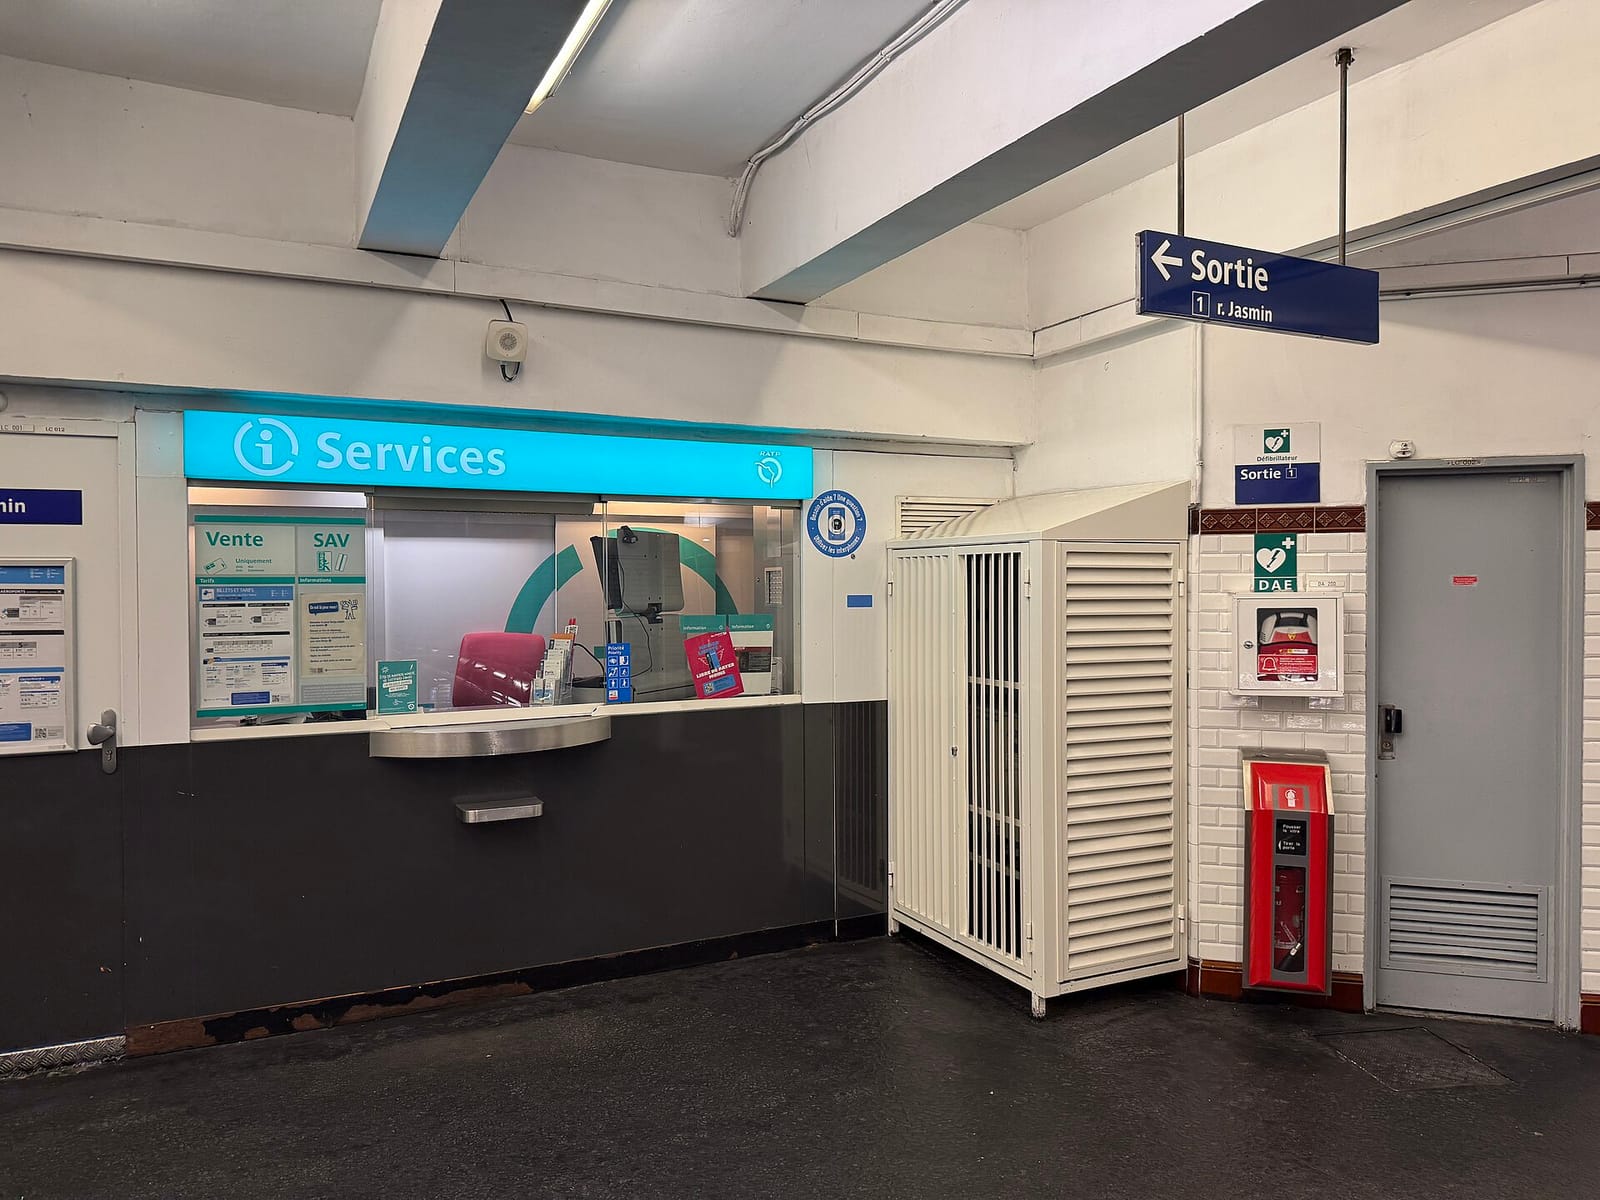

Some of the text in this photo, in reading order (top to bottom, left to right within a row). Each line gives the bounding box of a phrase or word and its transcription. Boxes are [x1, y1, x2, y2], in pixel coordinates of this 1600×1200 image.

[1191, 250, 1269, 292] Sortie
[1196, 296, 1273, 323] 1 r. Jasmin
[316, 431, 507, 476] Services
[1240, 468, 1281, 480] Sortie
[205, 531, 264, 547] Vente
[313, 532, 350, 548] SAV
[1258, 579, 1293, 591] DAE
